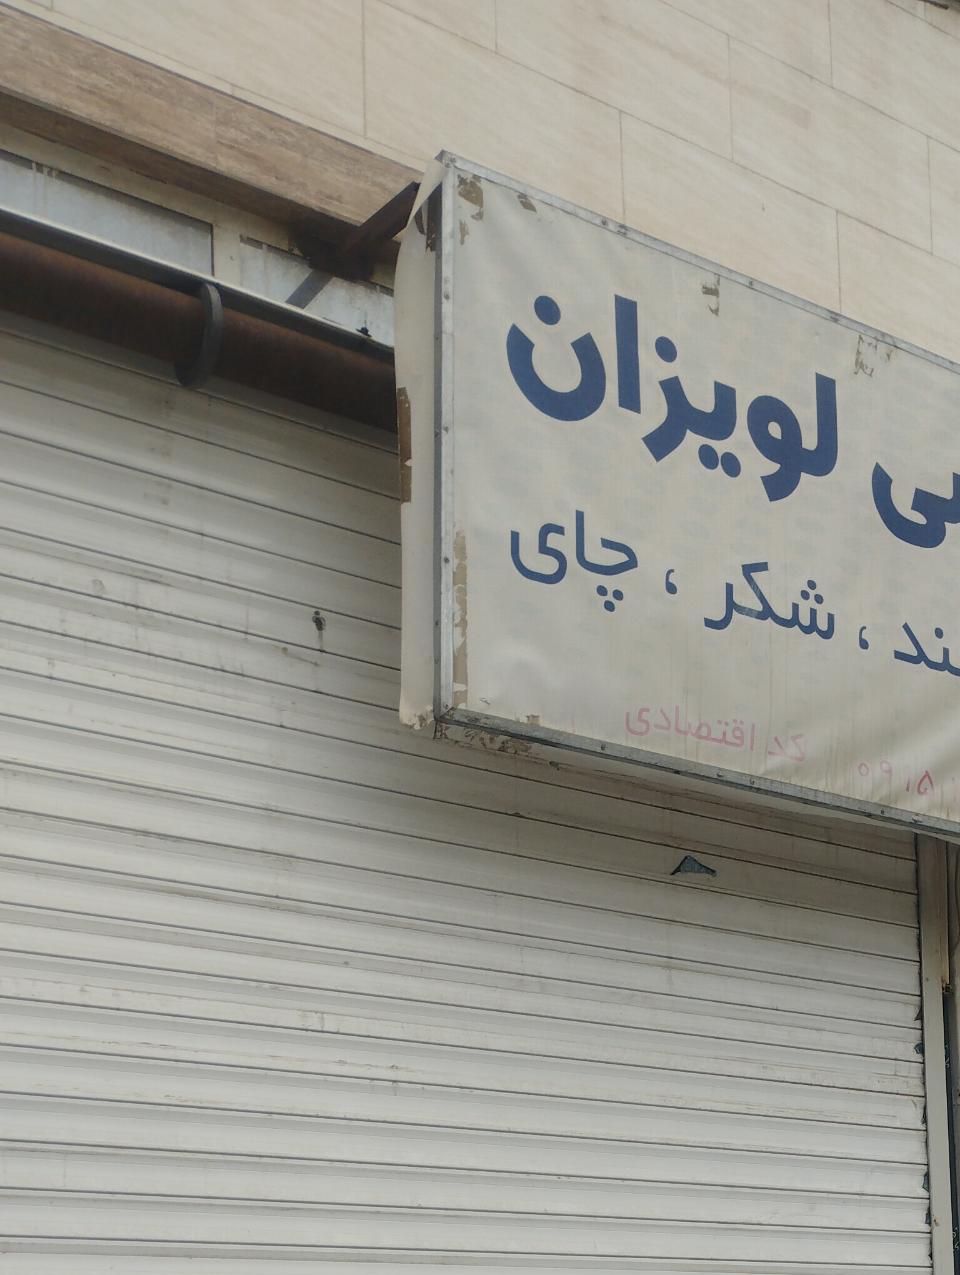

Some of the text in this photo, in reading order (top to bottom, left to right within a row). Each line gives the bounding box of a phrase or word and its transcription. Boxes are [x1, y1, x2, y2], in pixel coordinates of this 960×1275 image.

[507, 294, 838, 502] لویزان
[509, 509, 639, 613] چای
[703, 560, 835, 640] شکر
[623, 705, 756, 752] اقتصادی
[766, 732, 806, 763] کد
